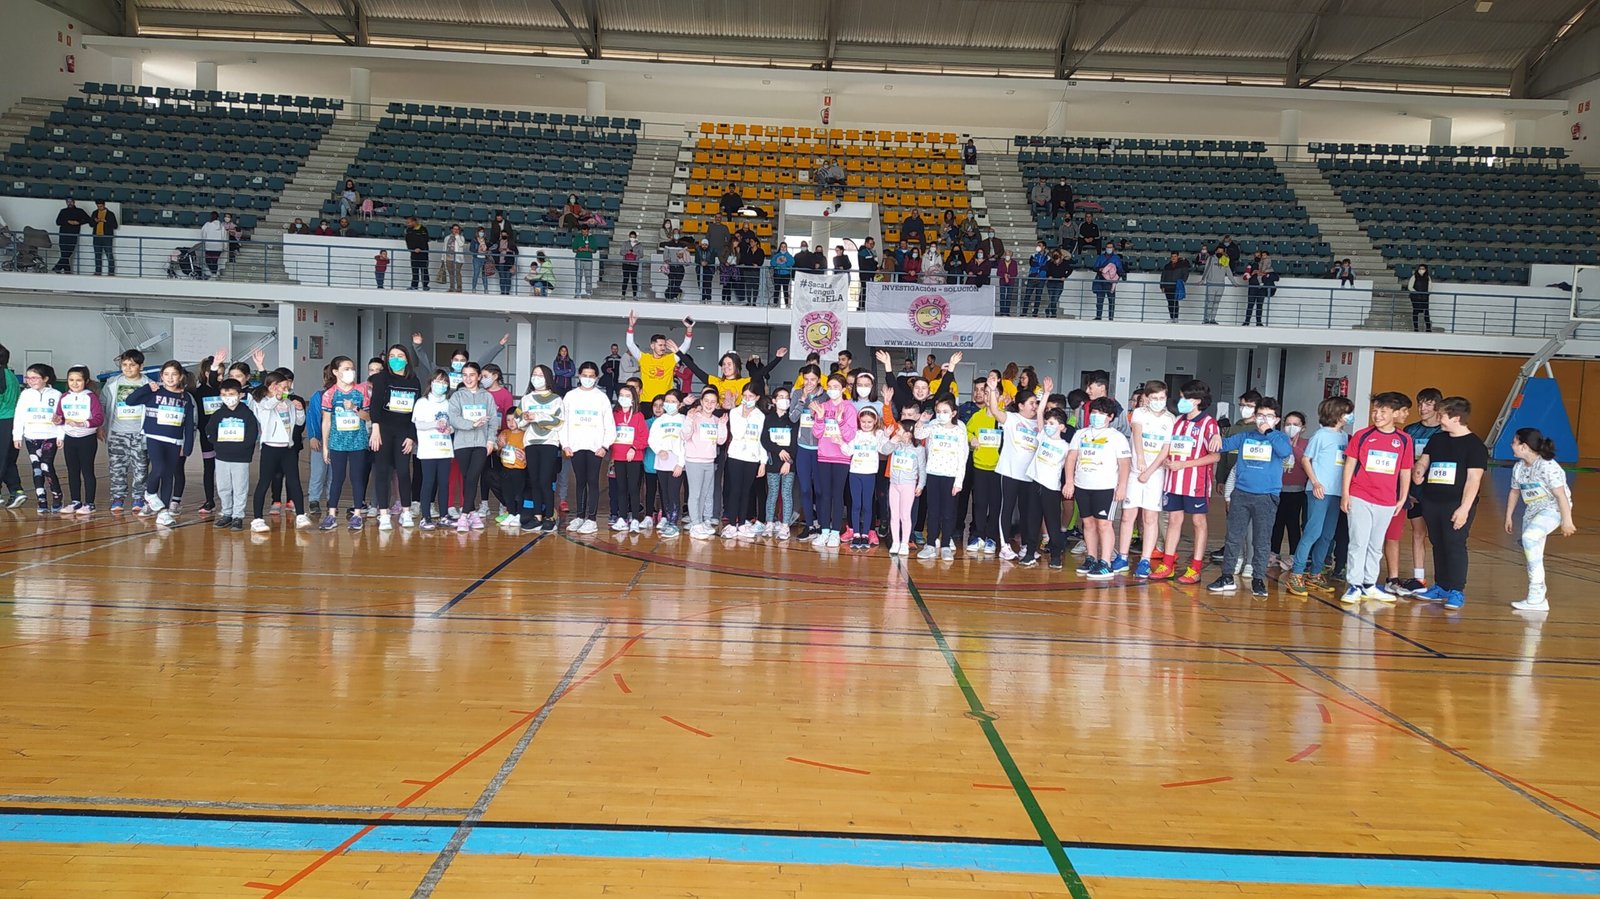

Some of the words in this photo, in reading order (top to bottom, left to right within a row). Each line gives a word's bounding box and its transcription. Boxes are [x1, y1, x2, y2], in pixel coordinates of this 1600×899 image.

[799, 278, 833, 290] #SacaLa
[881, 284, 937, 293] INVESTIGACIÓN
[943, 284, 979, 293] SOLUCIÓN
[809, 287, 835, 297] Lengua
[883, 339, 974, 348] WWW.SACALENGUAELA.COM
[48, 398, 55, 407] 8
[155, 395, 188, 407] FANCY
[1433, 469, 1447, 477] 018
